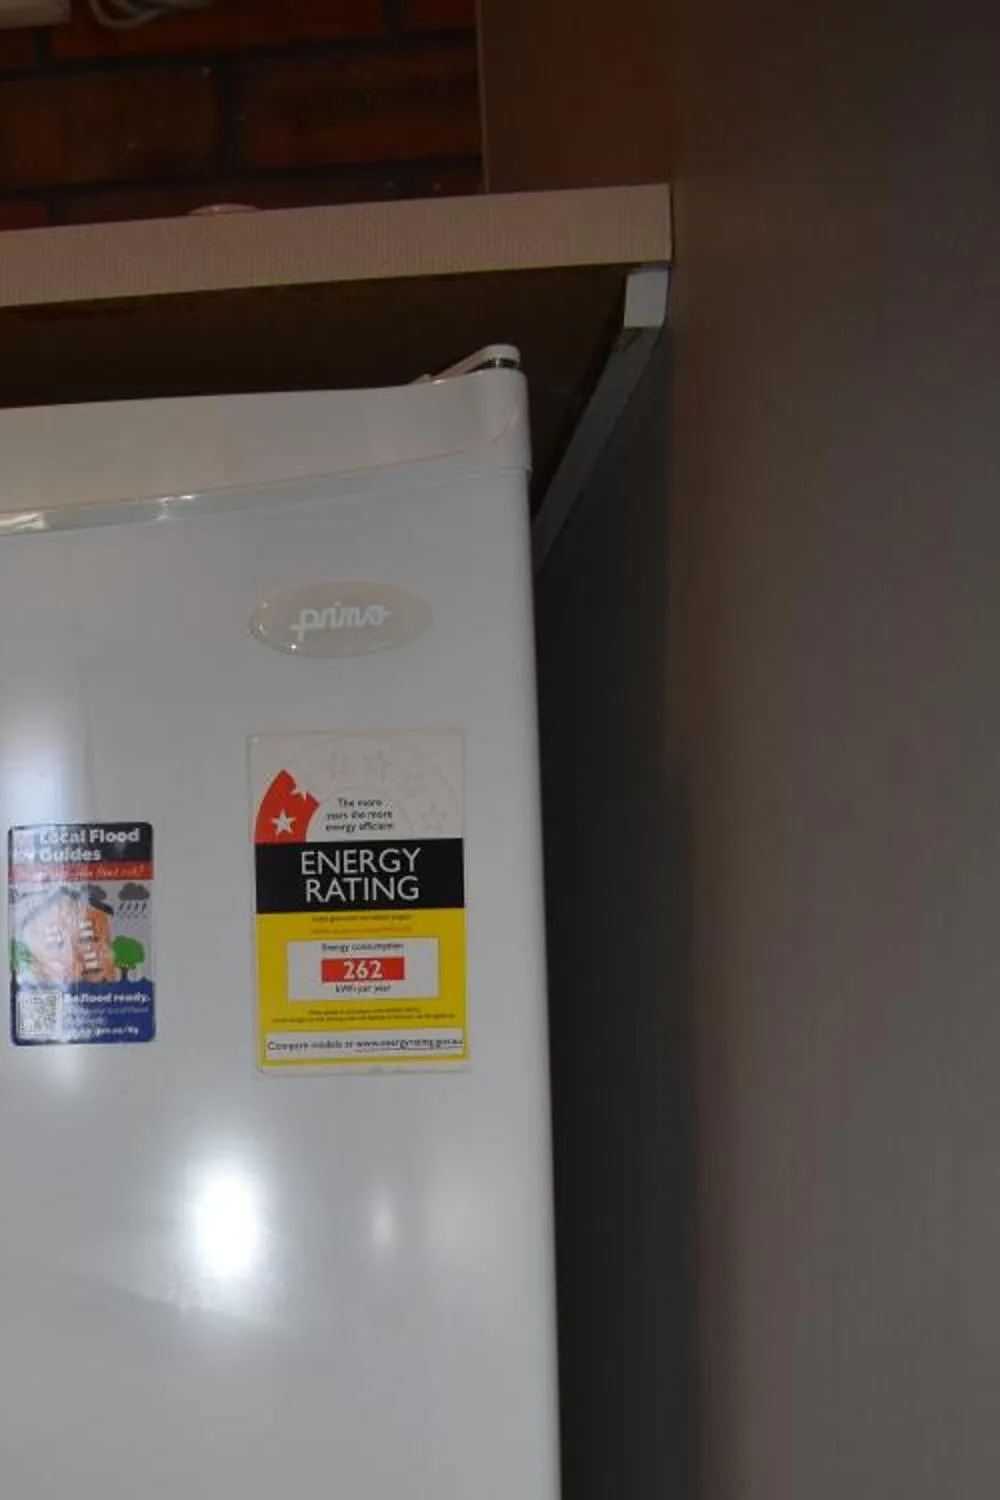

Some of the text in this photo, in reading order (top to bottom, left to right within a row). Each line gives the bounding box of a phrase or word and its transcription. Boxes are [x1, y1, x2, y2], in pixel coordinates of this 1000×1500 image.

[338, 797, 354, 807] The
[369, 811, 393, 819] more
[40, 827, 140, 843] Local Flood
[325, 824, 356, 834] energy
[39, 847, 101, 862] Guides
[301, 847, 421, 875] ENERGY
[306, 876, 420, 903] RATING
[322, 943, 349, 953] Energy
[343, 960, 383, 980] 262
[81, 992, 112, 1003] flood
[268, 1041, 309, 1054] Compare
